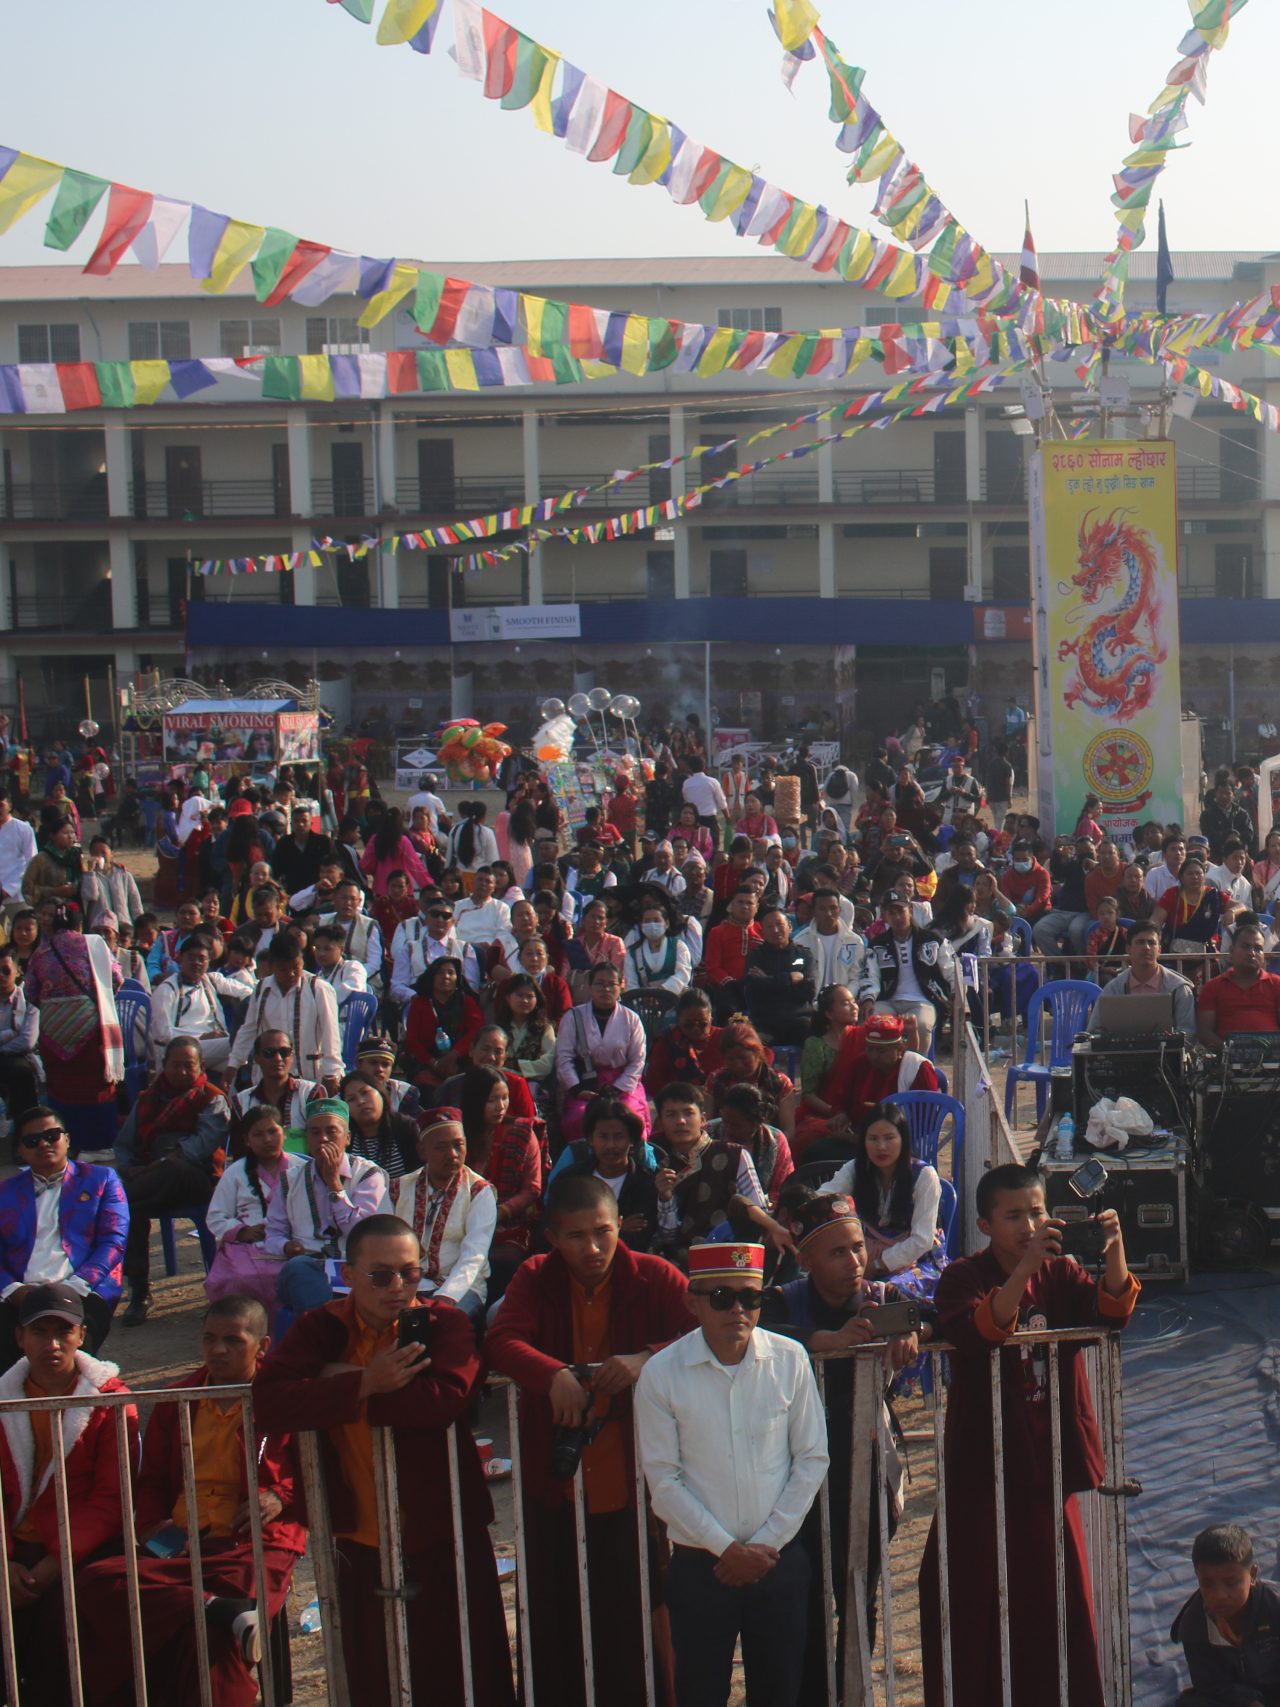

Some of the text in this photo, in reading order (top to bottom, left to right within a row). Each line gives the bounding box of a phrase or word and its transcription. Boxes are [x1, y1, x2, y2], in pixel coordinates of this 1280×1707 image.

[1088, 449, 1123, 468] सोनाम
[1128, 448, 1167, 470] ल्होछार
[506, 616, 576, 626] SMOOTH FINISH
[166, 715, 274, 729] VIRAL SMOKING
